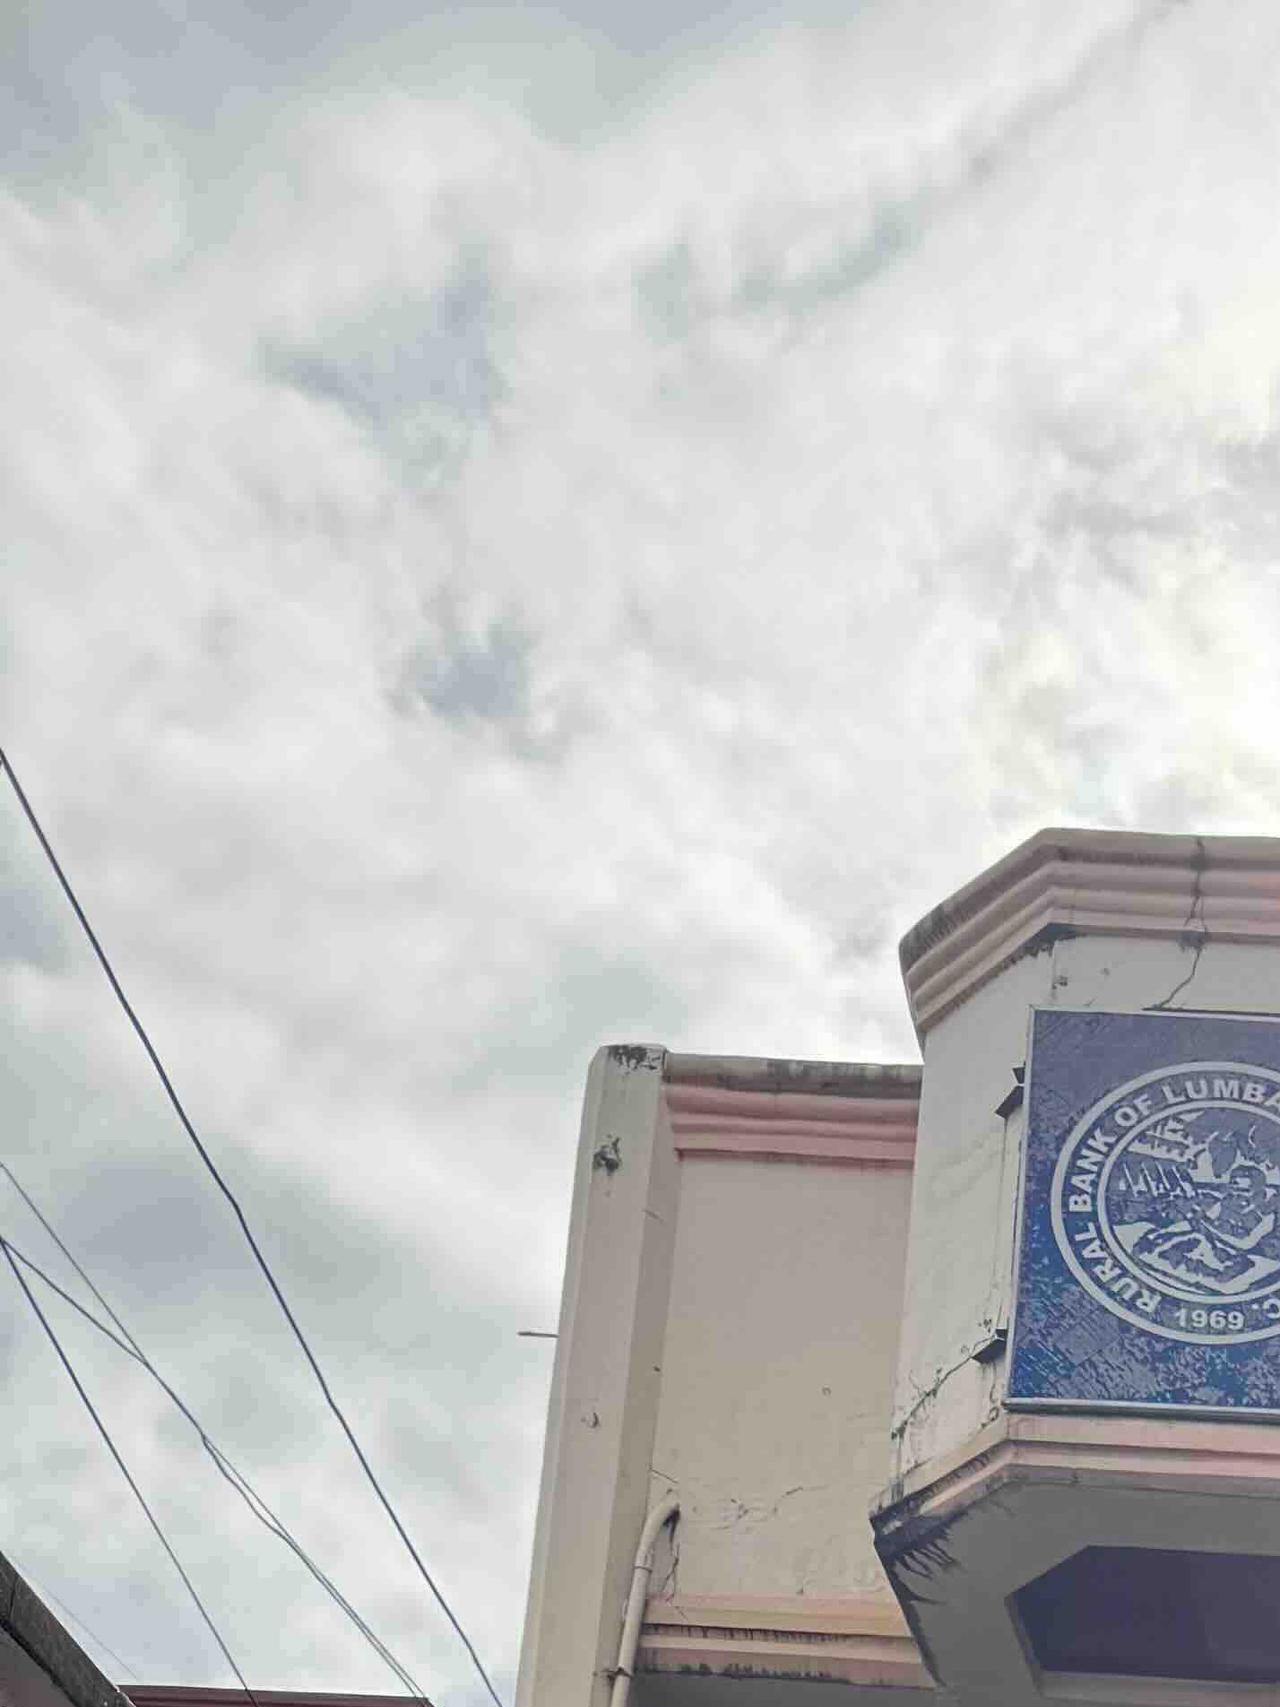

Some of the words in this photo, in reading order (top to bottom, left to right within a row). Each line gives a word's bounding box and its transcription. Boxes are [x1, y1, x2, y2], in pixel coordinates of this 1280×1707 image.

[1115, 1094, 1154, 1127] OF
[1069, 1128, 1117, 1213] BANK
[1075, 1222, 1163, 1314] RURAL
[1173, 1308, 1245, 1331] 1969
